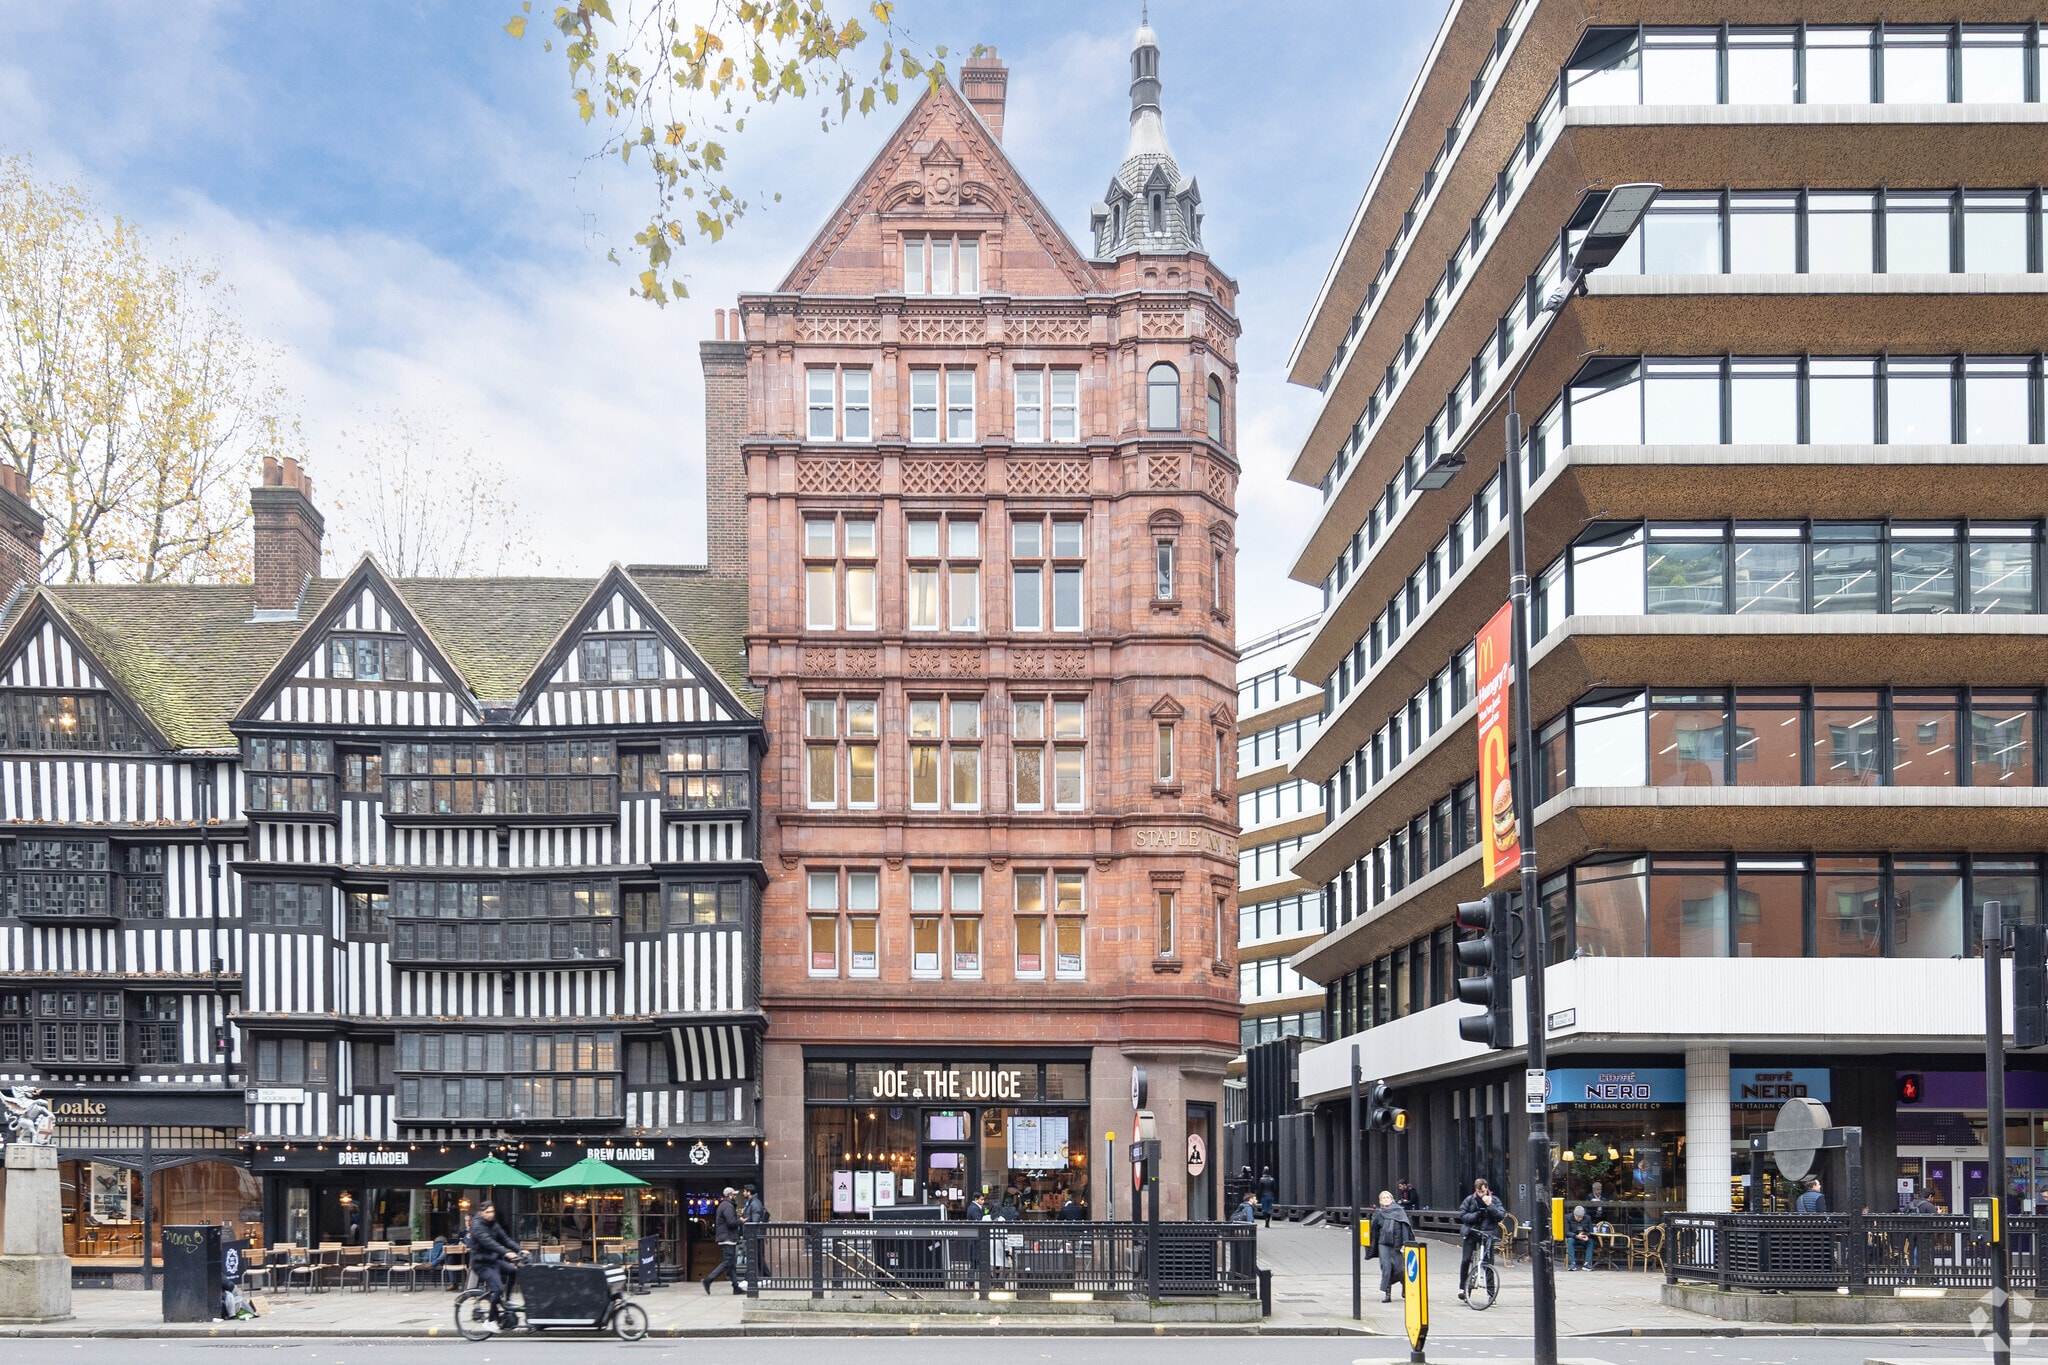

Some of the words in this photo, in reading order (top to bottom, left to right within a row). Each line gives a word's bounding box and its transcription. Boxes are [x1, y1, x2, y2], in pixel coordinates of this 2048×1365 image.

[1479, 662, 1508, 705] Hungry?
[1136, 830, 1200, 847] STAPLE
[873, 1070, 909, 1098] JOE
[912, 1088, 924, 1098] &
[924, 1070, 960, 1098] THE
[966, 1070, 1021, 1098] JUICE
[1586, 1084, 1651, 1100] NERO
[1742, 1083, 1808, 1100] NERO
[47, 1098, 107, 1115] Loake
[338, 1152, 367, 1165] BREW
[369, 1152, 409, 1165] GARDEN
[587, 1148, 615, 1160] BREW
[616, 1148, 655, 1160] GARDEN
